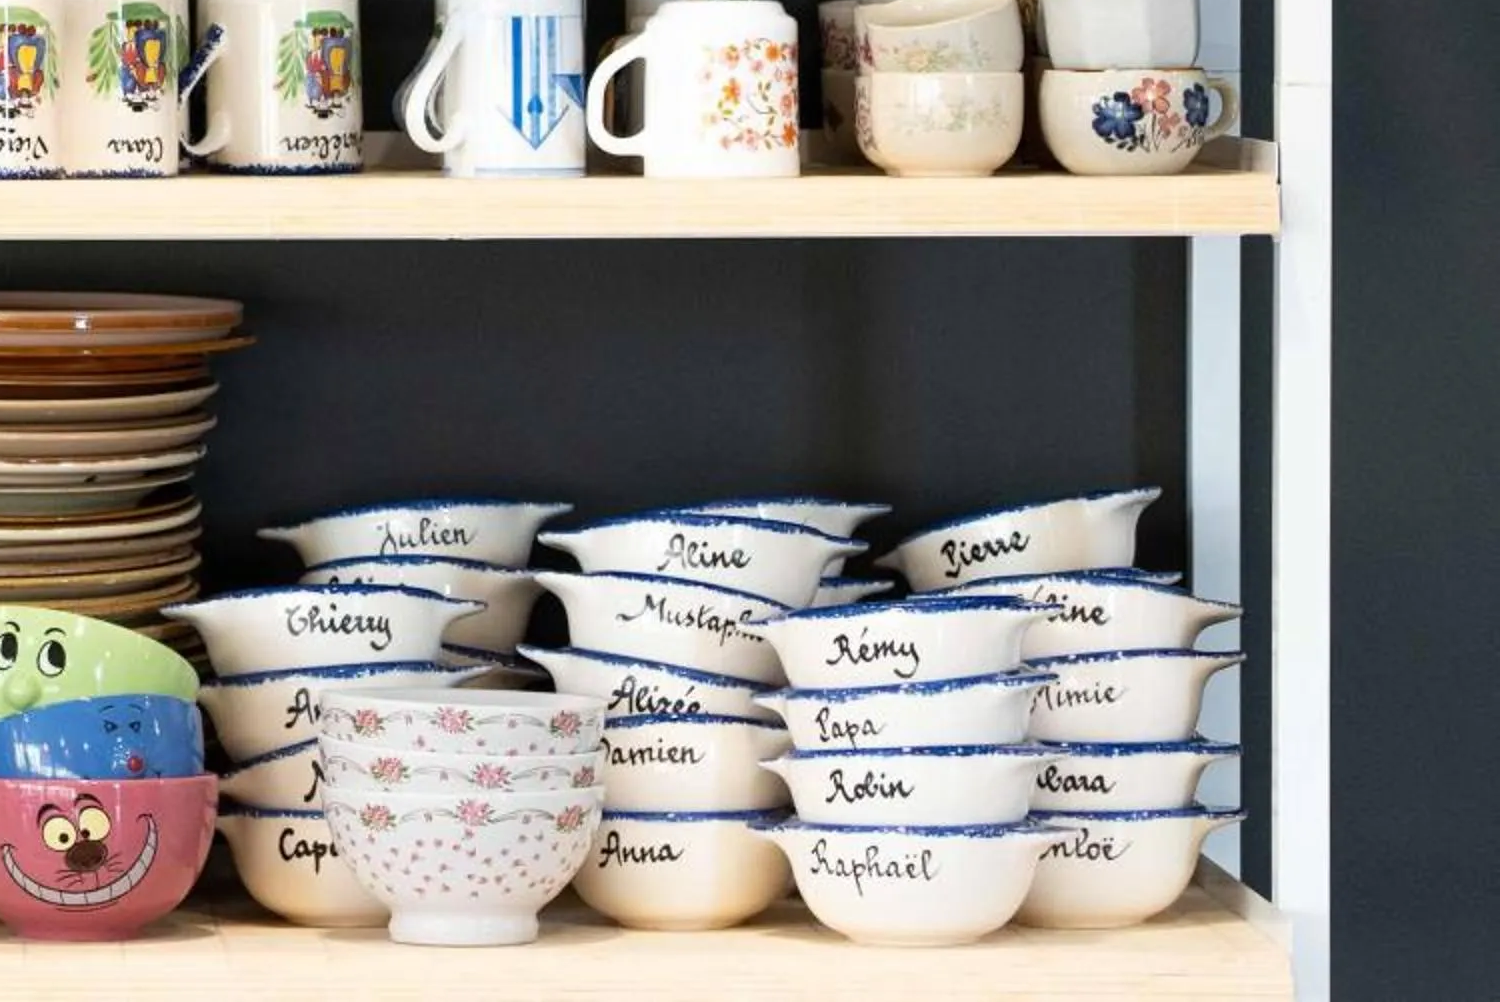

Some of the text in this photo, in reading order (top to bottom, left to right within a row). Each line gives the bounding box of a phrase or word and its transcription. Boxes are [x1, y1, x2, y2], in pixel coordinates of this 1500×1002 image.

[376, 517, 478, 555] Julien
[657, 533, 752, 571] Aline
[940, 530, 1030, 579] Pierre
[285, 601, 393, 651] Thierry
[615, 594, 766, 647] Mustap
[826, 626, 920, 679] Rémy
[814, 706, 887, 750] Papa
[825, 768, 915, 804] Robin
[599, 829, 685, 869] Anna
[810, 838, 940, 897] Raphaël
